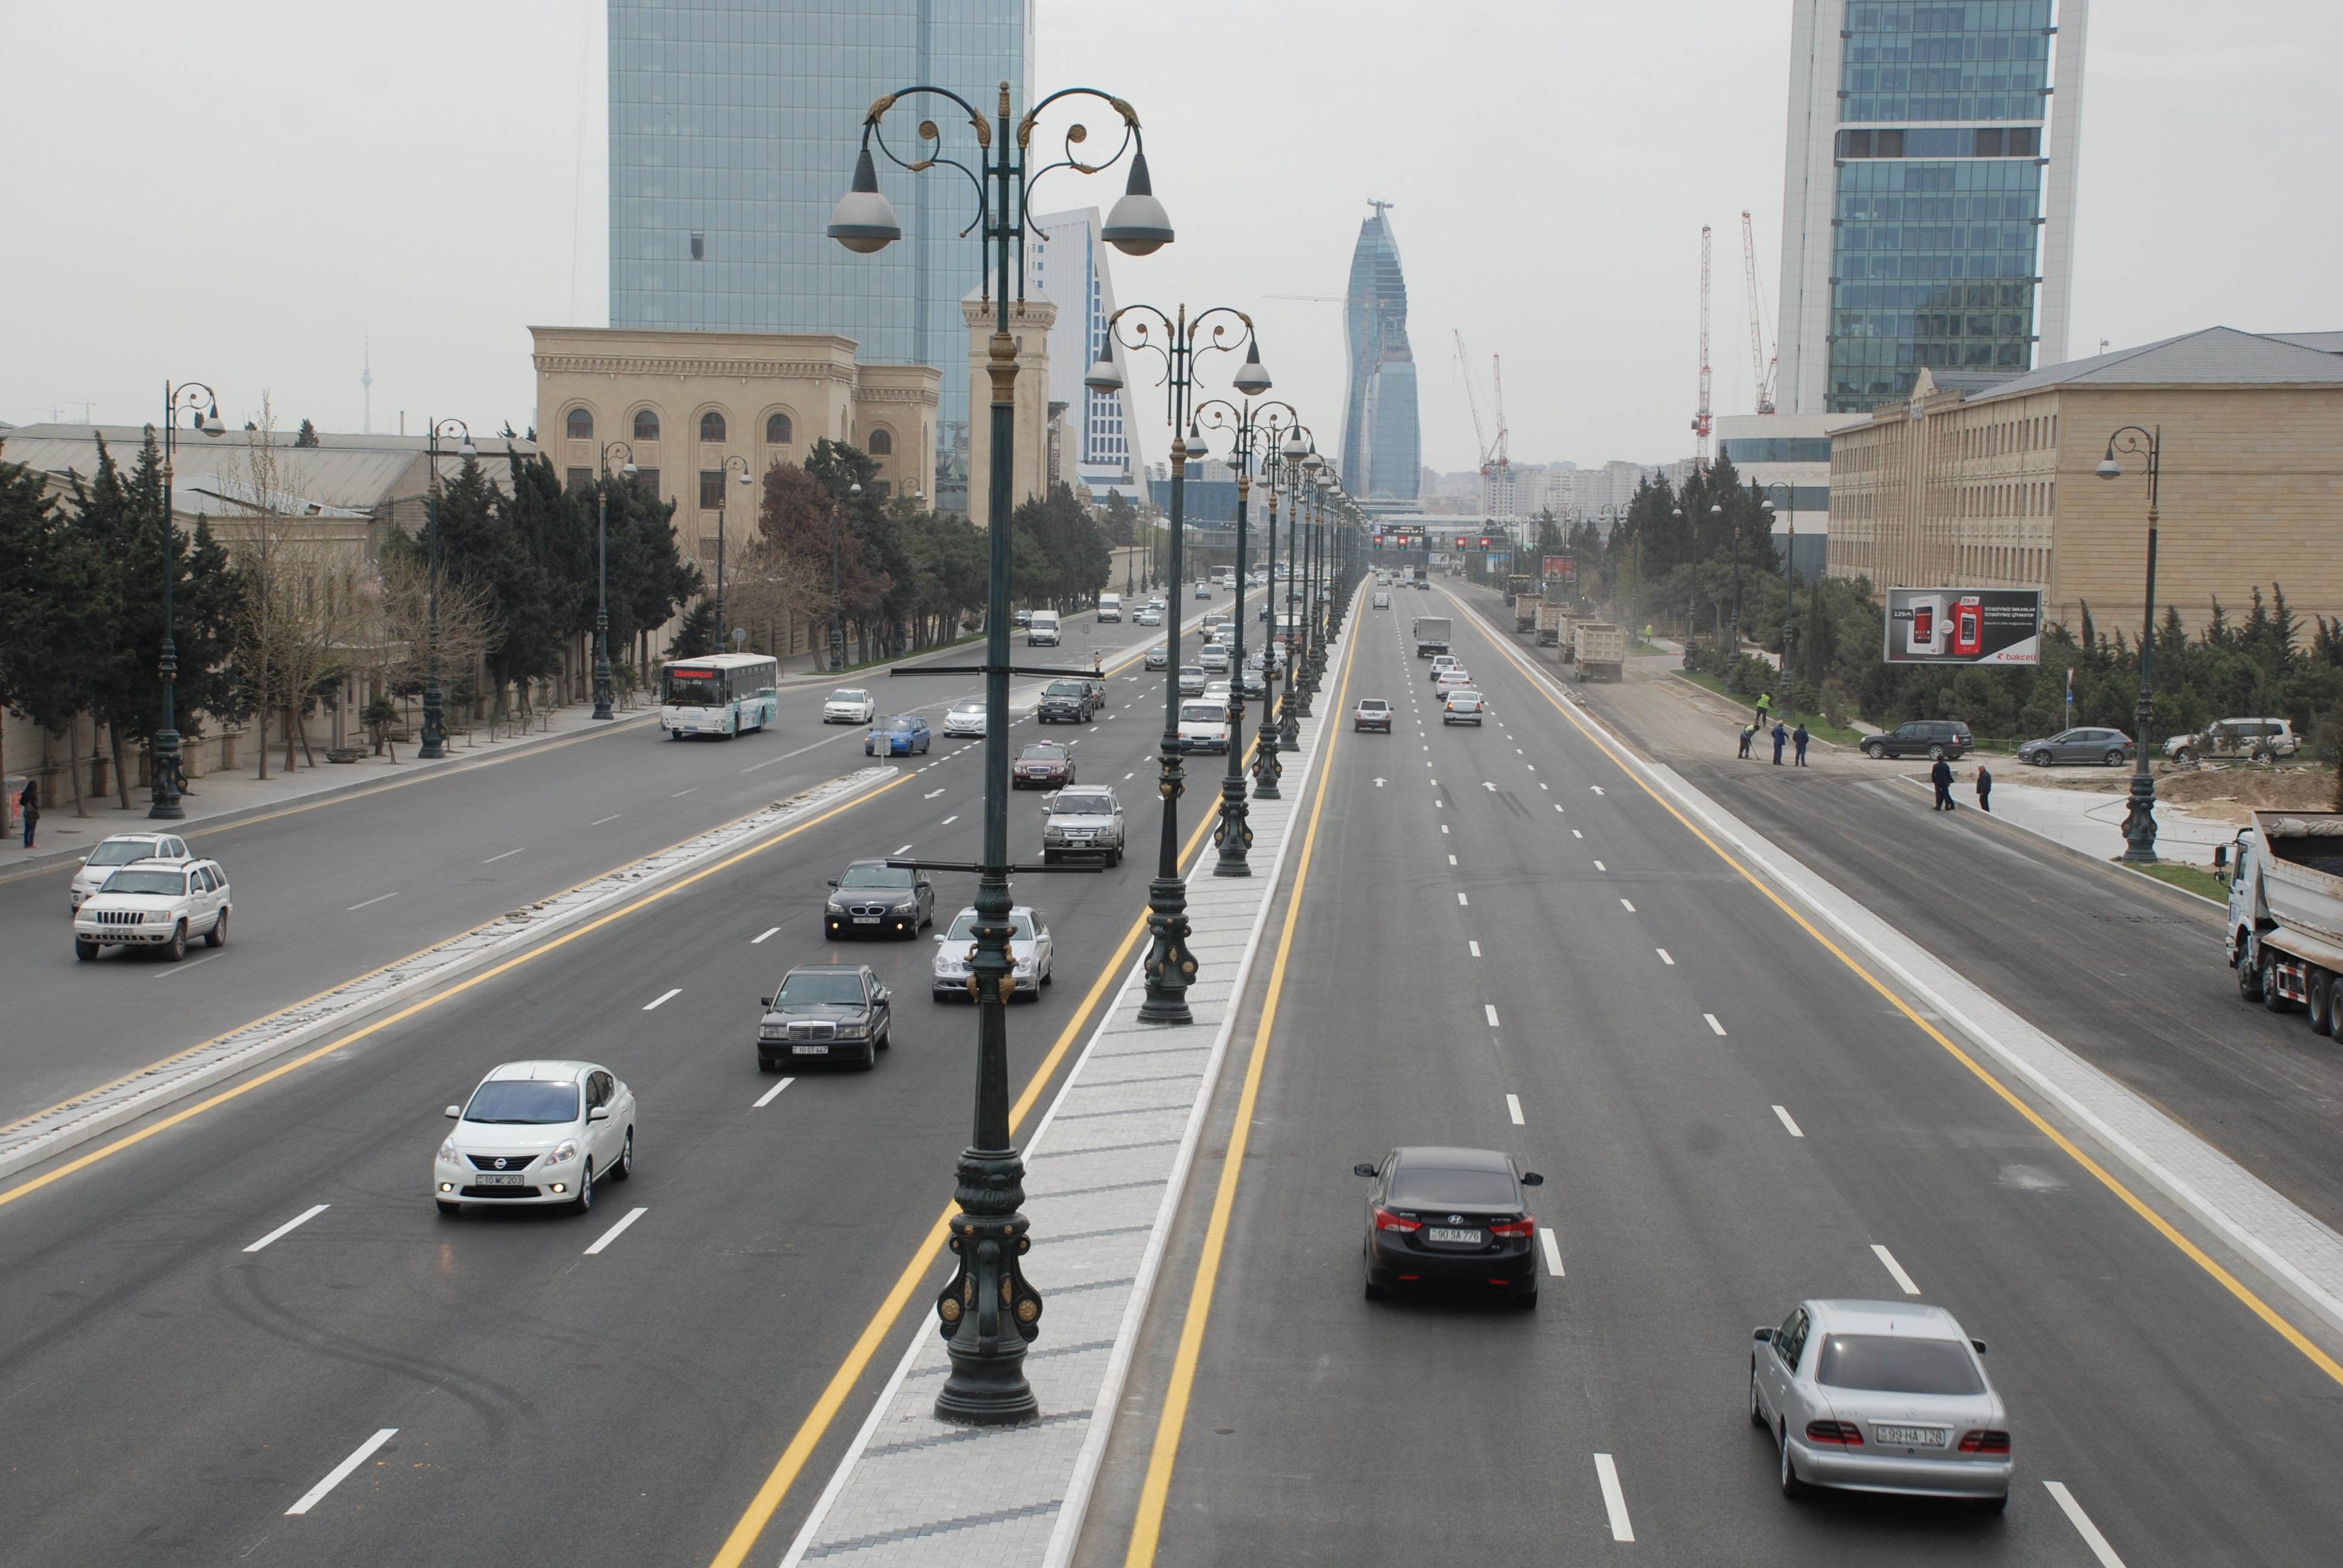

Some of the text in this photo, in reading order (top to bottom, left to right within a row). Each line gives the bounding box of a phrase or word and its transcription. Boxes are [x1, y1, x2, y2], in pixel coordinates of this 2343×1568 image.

[1438, 1230, 1480, 1241] 90 SA 776
